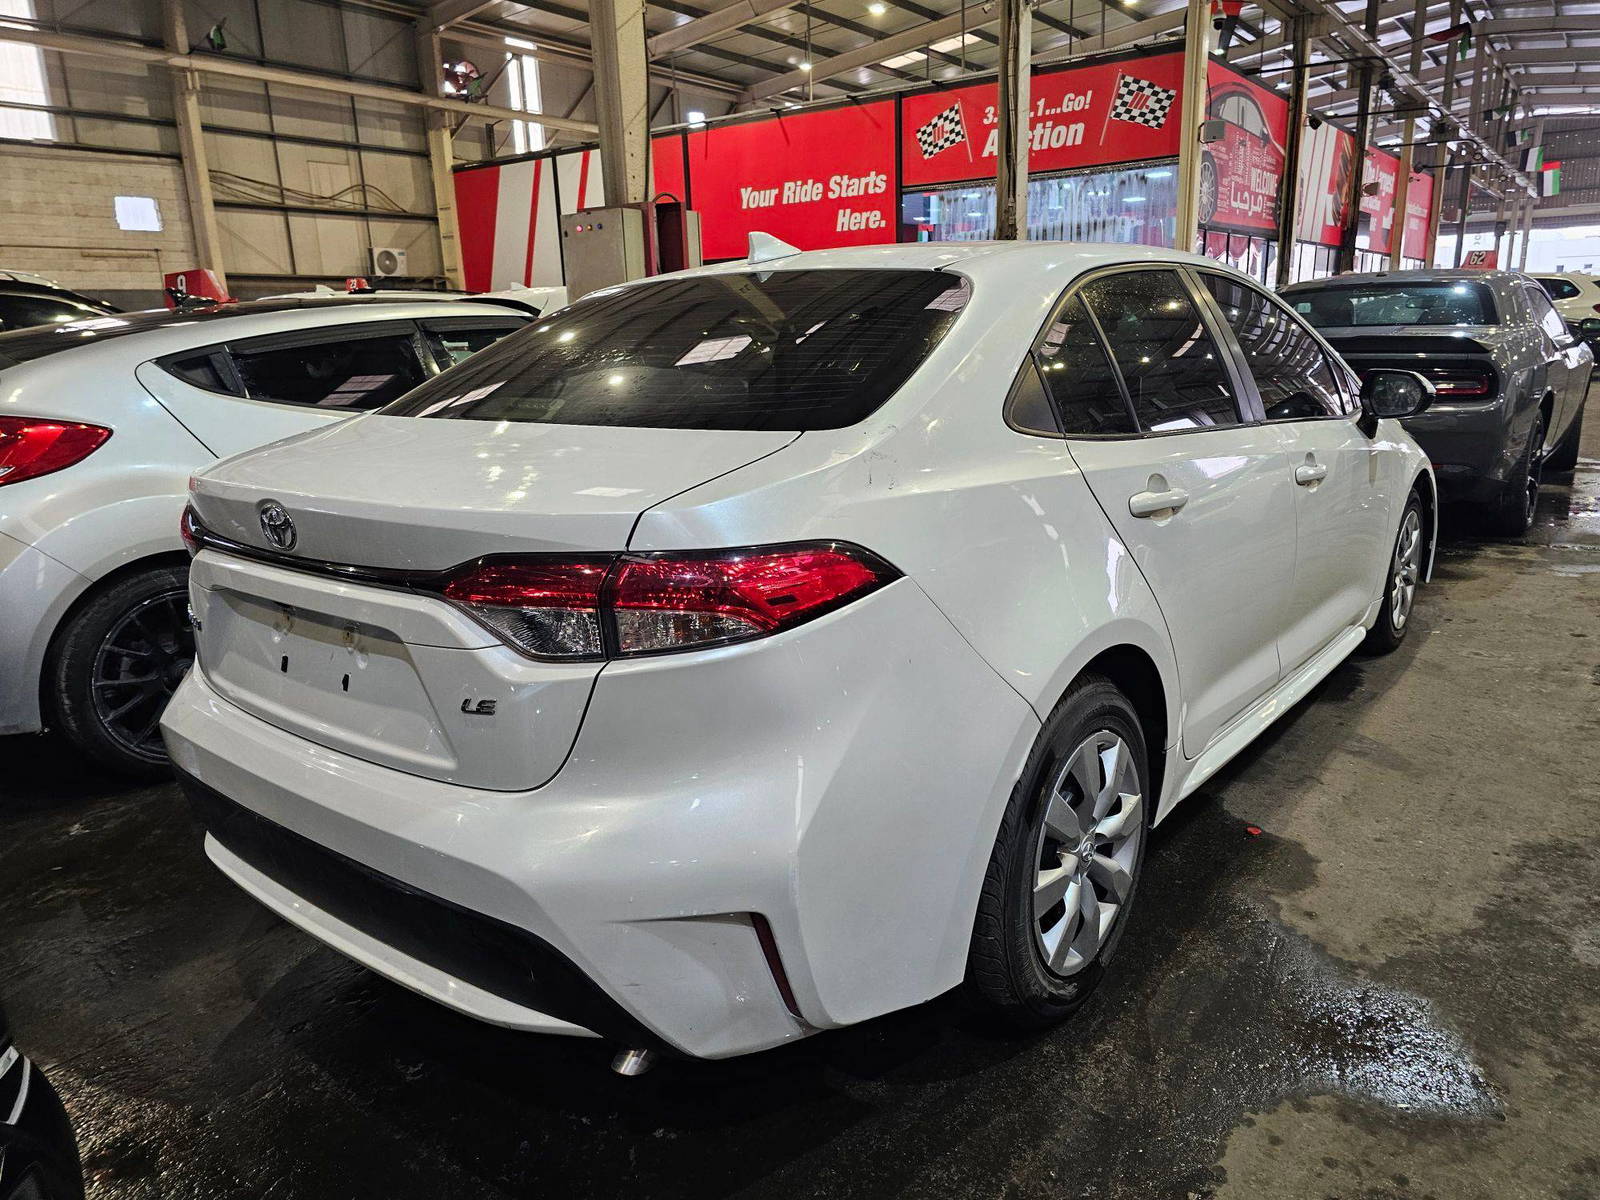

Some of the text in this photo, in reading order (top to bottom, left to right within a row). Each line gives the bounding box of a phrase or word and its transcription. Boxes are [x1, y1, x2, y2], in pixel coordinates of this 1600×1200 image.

[981, 121, 1085, 158] Ation
[740, 170, 888, 209] Your Ride Starts
[1250, 166, 1278, 197] WELCOME
[1230, 181, 1264, 217] مرحبا
[836, 208, 886, 232] Here.
[1470, 251, 1486, 265] 62
[461, 698, 497, 716] LE
